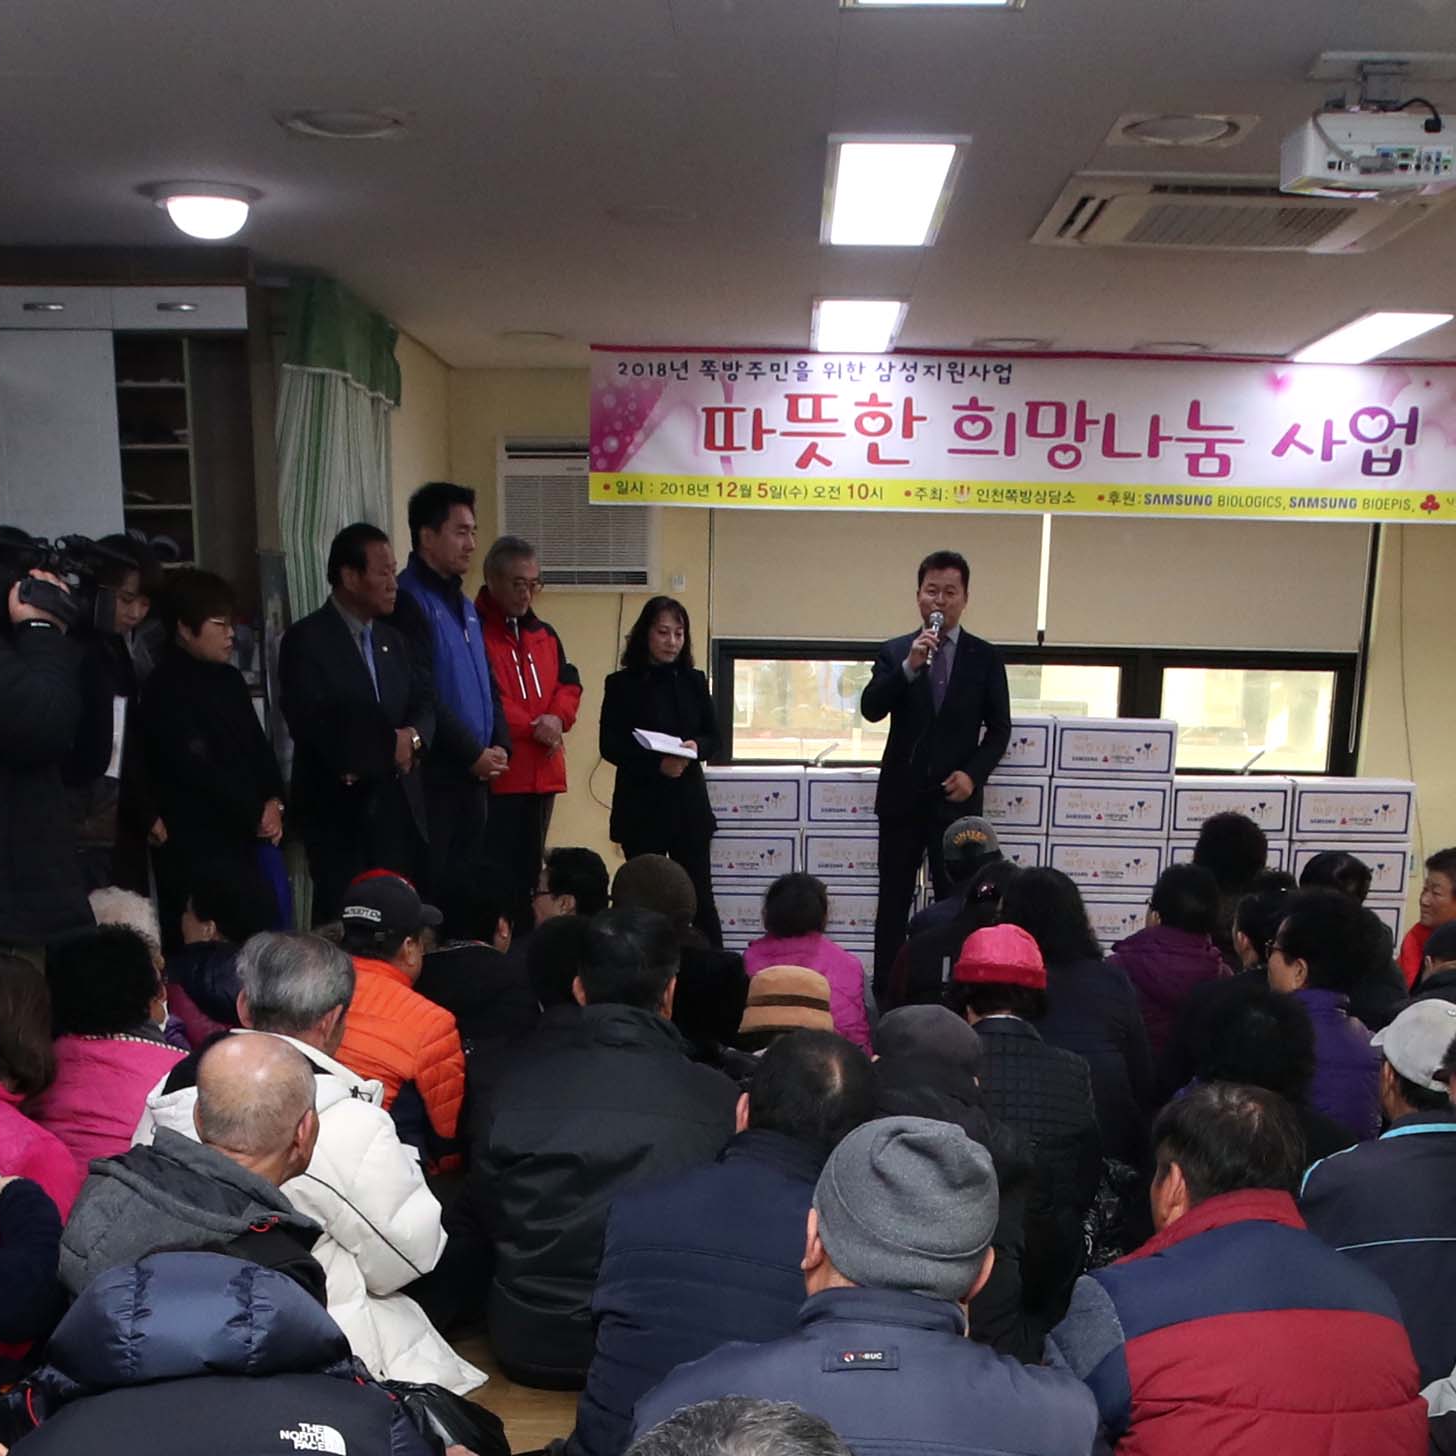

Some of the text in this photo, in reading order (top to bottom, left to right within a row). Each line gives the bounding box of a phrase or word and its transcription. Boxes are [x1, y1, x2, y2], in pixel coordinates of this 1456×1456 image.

[617, 359, 1013, 385] 2018년 쪽방주민을 위한 삼성지원사업
[701, 392, 1420, 478] 따뜻한 희망나눔 사업
[615, 480, 644, 494] 일시
[660, 482, 709, 498] 2018년
[716, 482, 752, 499] 12월
[813, 485, 841, 500] 오전
[847, 483, 884, 501] 10시
[1144, 493, 1214, 506] SAMSUNG
[1289, 497, 1357, 509] SAMSUNG
[279, 1430, 324, 1442] NORTH
[298, 1423, 324, 1433] THE
[294, 1440, 326, 1451] FACE
